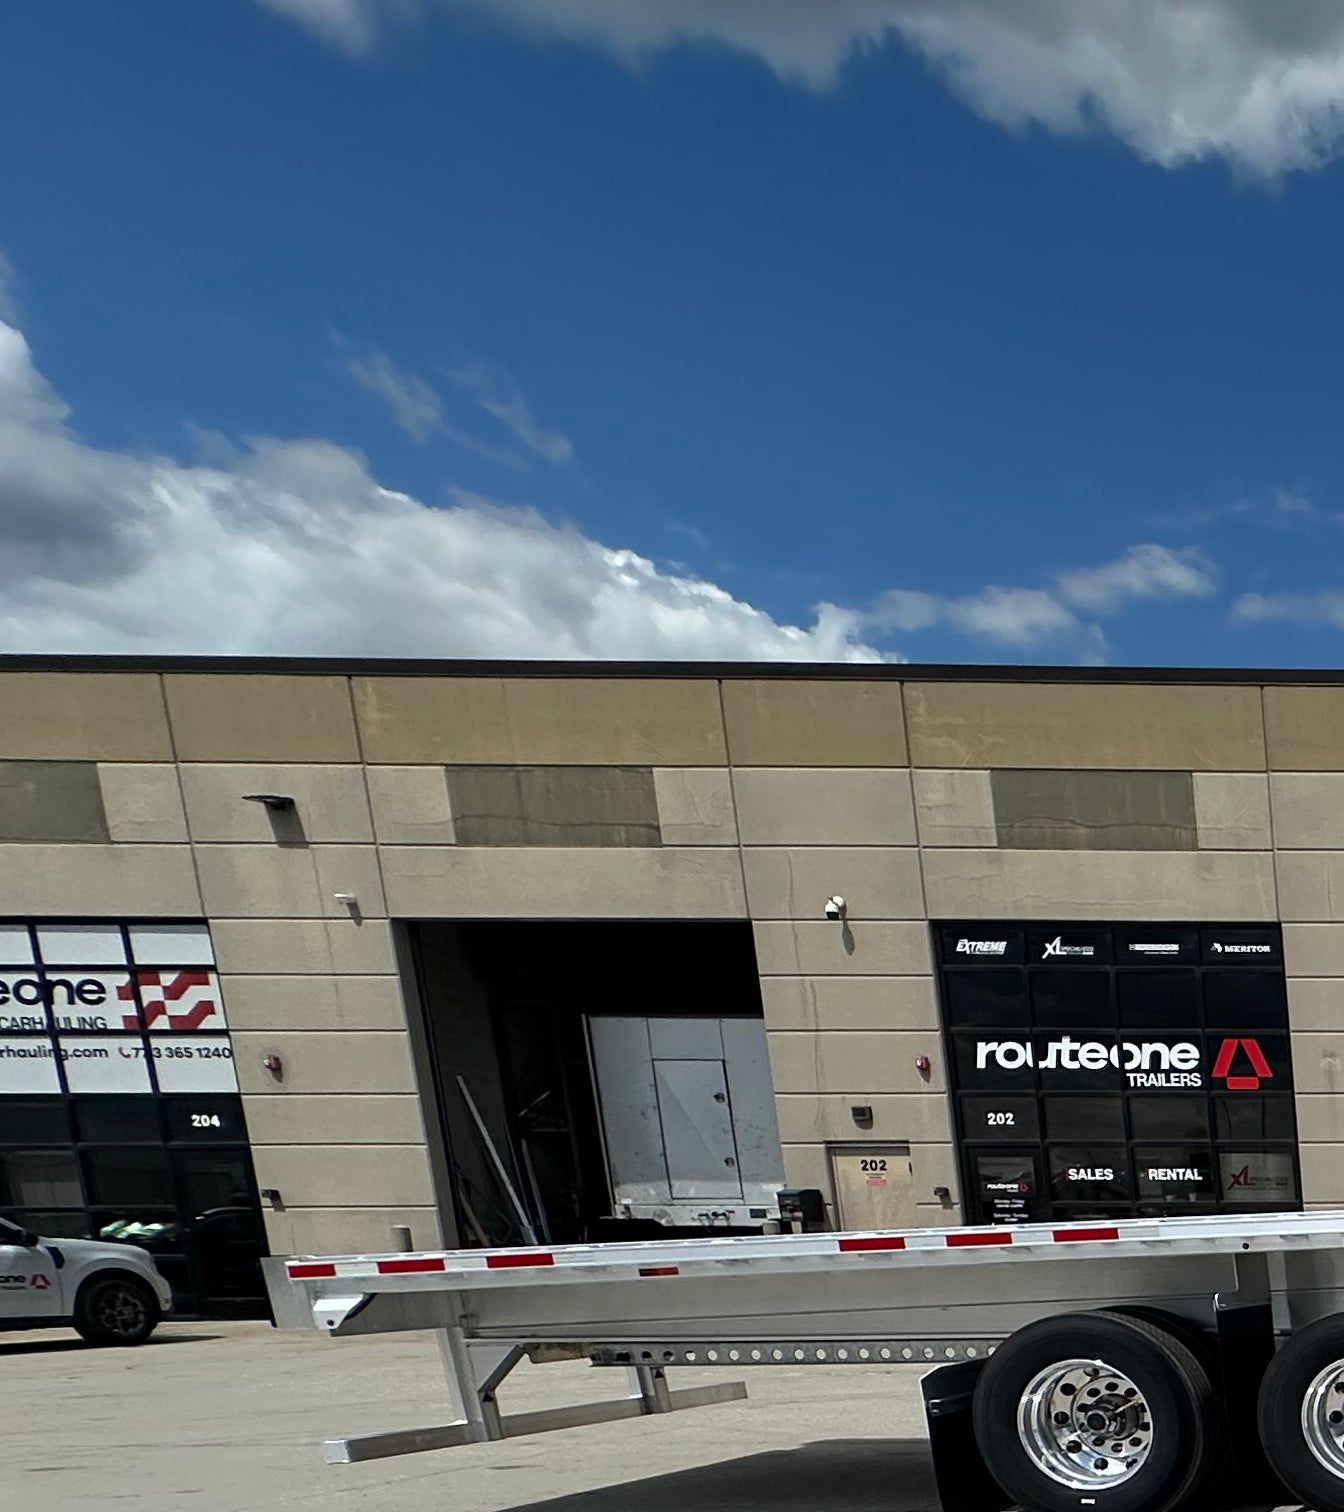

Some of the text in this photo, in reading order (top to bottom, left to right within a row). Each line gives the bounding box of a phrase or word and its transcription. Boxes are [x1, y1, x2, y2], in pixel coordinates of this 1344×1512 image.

[0, 1016, 107, 1029] CARHULING
[166, 1047, 193, 1059] 365
[195, 1047, 232, 1059] 1240
[976, 1036, 1200, 1070] routeone
[1126, 1072, 1202, 1087] TRAILERS
[191, 1114, 221, 1127] 204
[987, 1112, 1015, 1126] 202
[860, 1159, 887, 1171] 202
[1068, 1168, 1114, 1181] SALES
[1148, 1168, 1203, 1181] RENTAL
